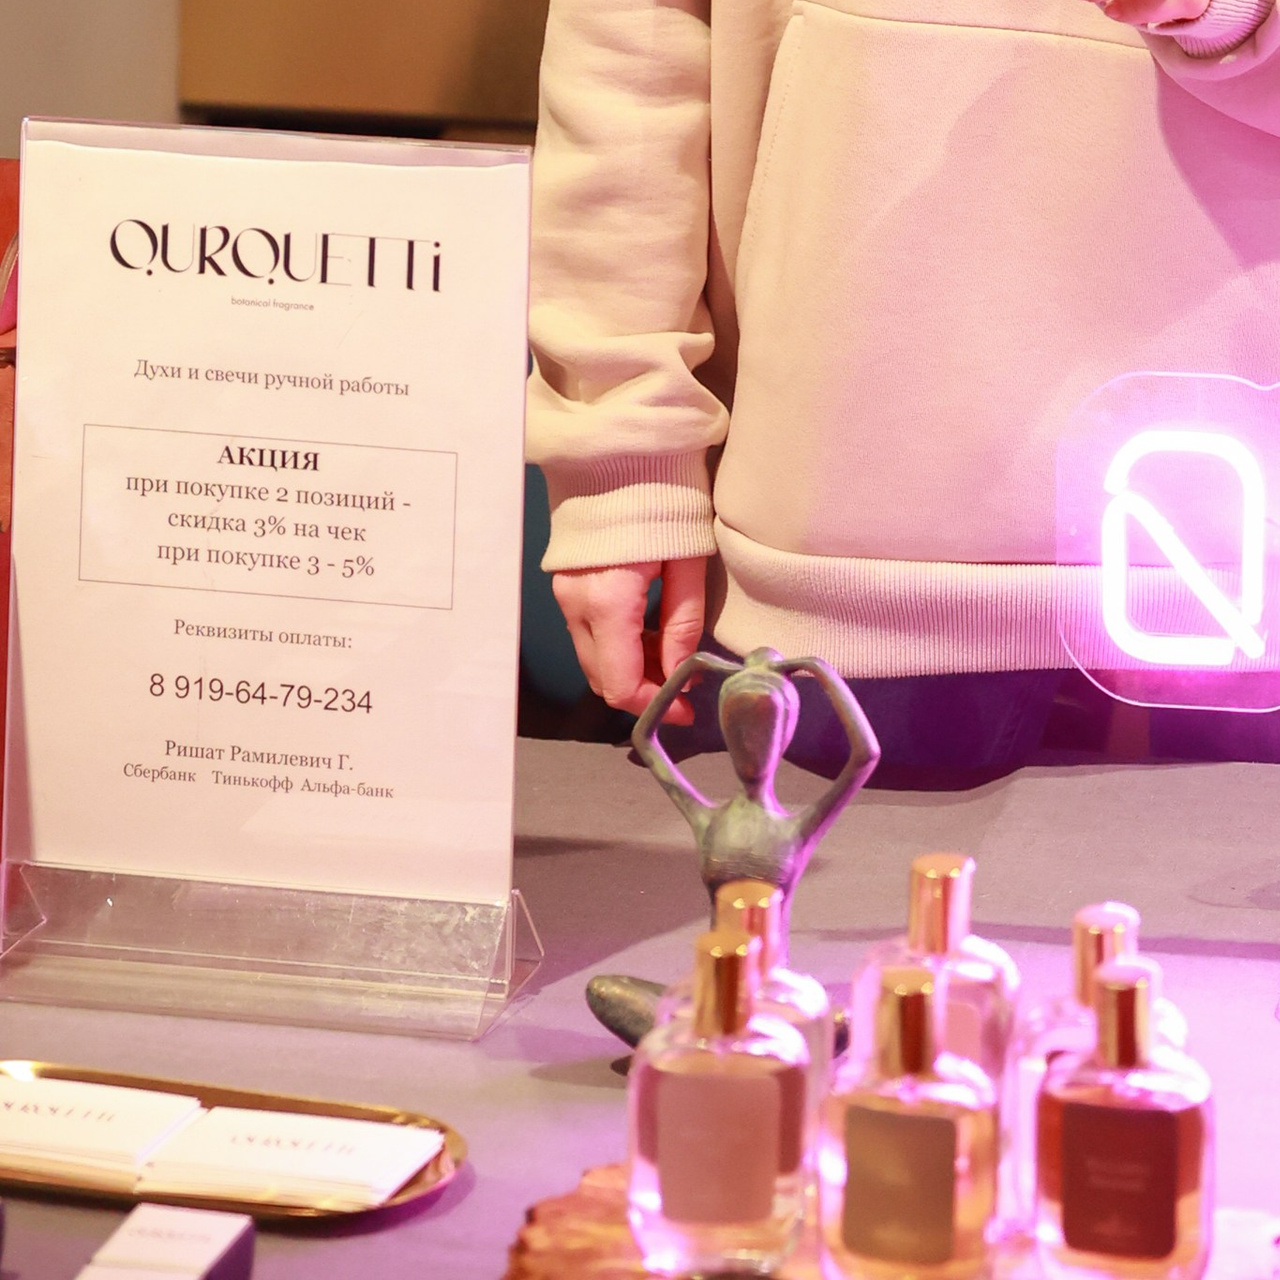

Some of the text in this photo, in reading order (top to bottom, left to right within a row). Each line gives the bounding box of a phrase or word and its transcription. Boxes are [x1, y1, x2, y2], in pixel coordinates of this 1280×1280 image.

[230, 295, 315, 312] botanical fragrance
[133, 358, 410, 397] Духи и свечи ручной работы
[217, 445, 321, 473] АКЦИЯ
[125, 476, 169, 497] при
[175, 480, 270, 503] покупке
[275, 486, 289, 503] 2
[295, 489, 396, 512] позиций
[167, 512, 367, 543] скидка 3% на чек
[156, 544, 201, 566] при
[206, 548, 301, 572] покупке
[306, 555, 320, 576] 3
[341, 554, 375, 579] 5%
[173, 618, 352, 649] Реквизиты оплаты:
[149, 672, 374, 715] 8 919-64-79-234
[164, 739, 354, 771] Ришат Рамилевич Г.
[122, 762, 394, 799] Сбербанк Тинькофф Альфа-банк
